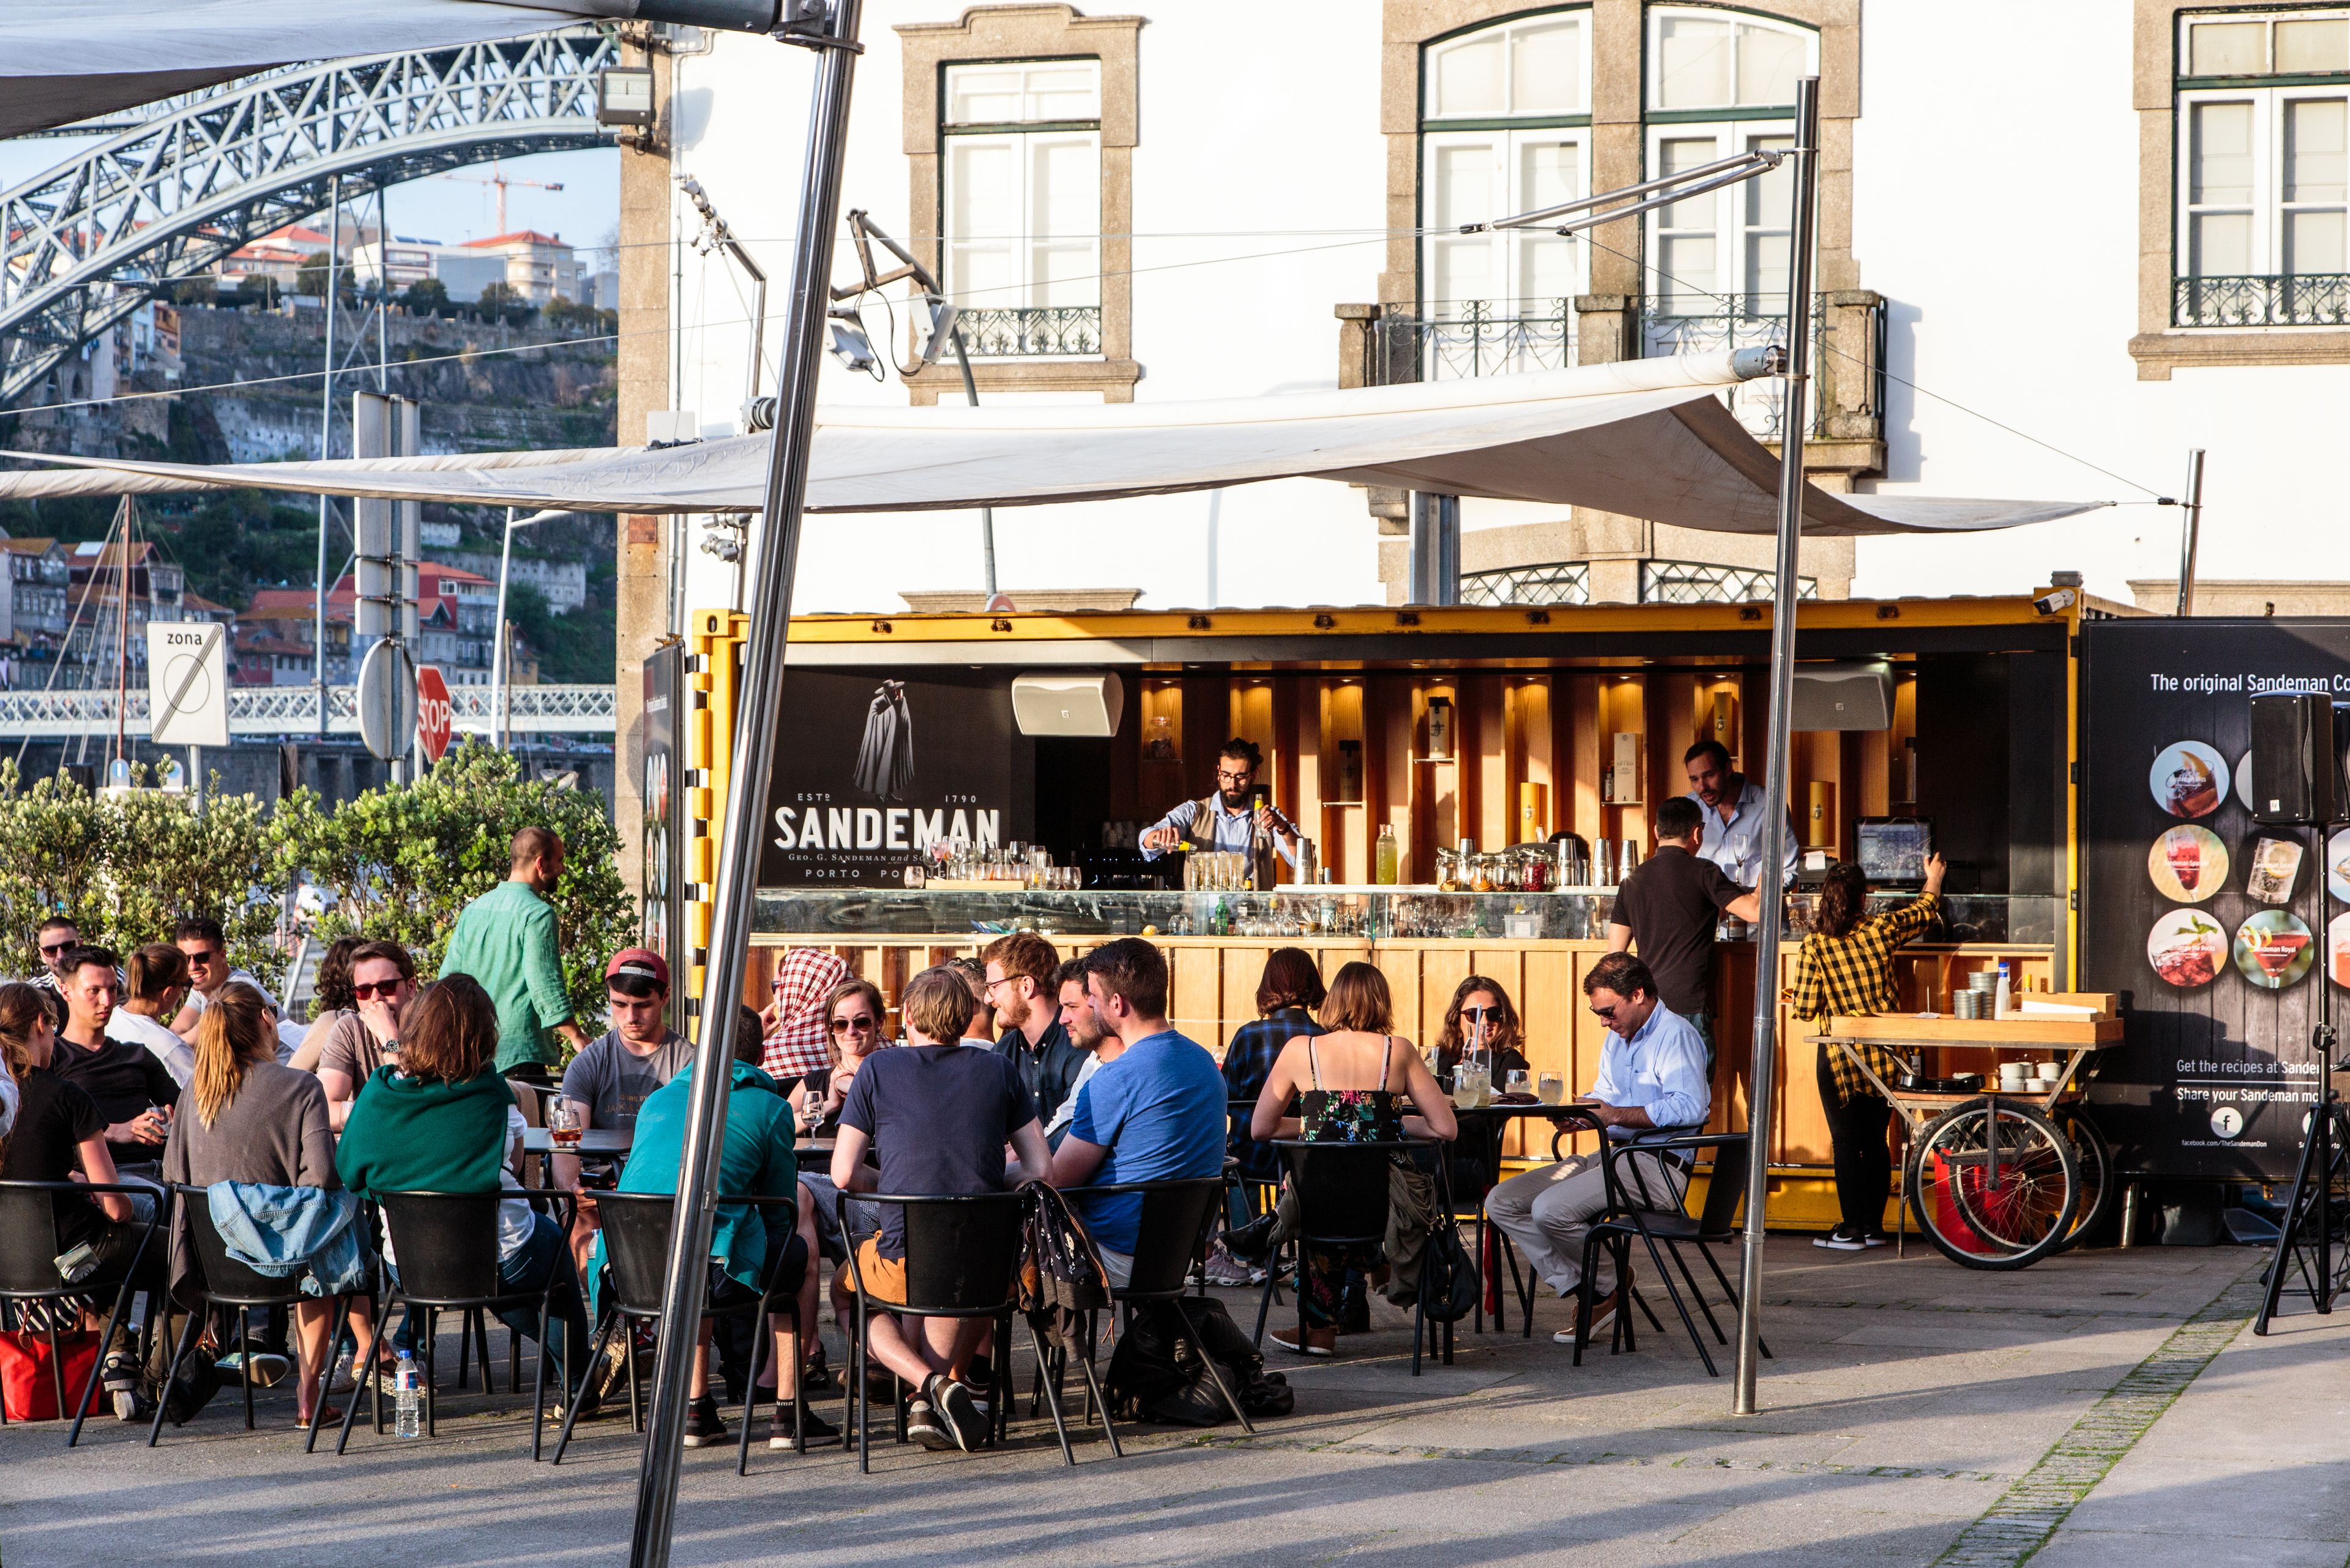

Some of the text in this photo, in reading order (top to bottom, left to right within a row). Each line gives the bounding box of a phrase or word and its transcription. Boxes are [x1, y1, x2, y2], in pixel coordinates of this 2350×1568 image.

[167, 633, 202, 645] zona
[2150, 673, 2179, 691] The
[2183, 673, 2242, 695] original
[2247, 674, 2329, 692] Sandeman
[946, 794, 977, 803] 1790
[774, 806, 999, 849] SANDEMAN
[805, 869, 860, 878] PORTO
[2177, 1059, 2196, 1072] Get
[2199, 1061, 2218, 1072] the
[2221, 1061, 2263, 1075] recipes
[2266, 1062, 2278, 1073] at
[2177, 1087, 2210, 1100] Share
[2212, 1089, 2238, 1103] your
[2240, 1089, 2299, 1102] Sandeman
